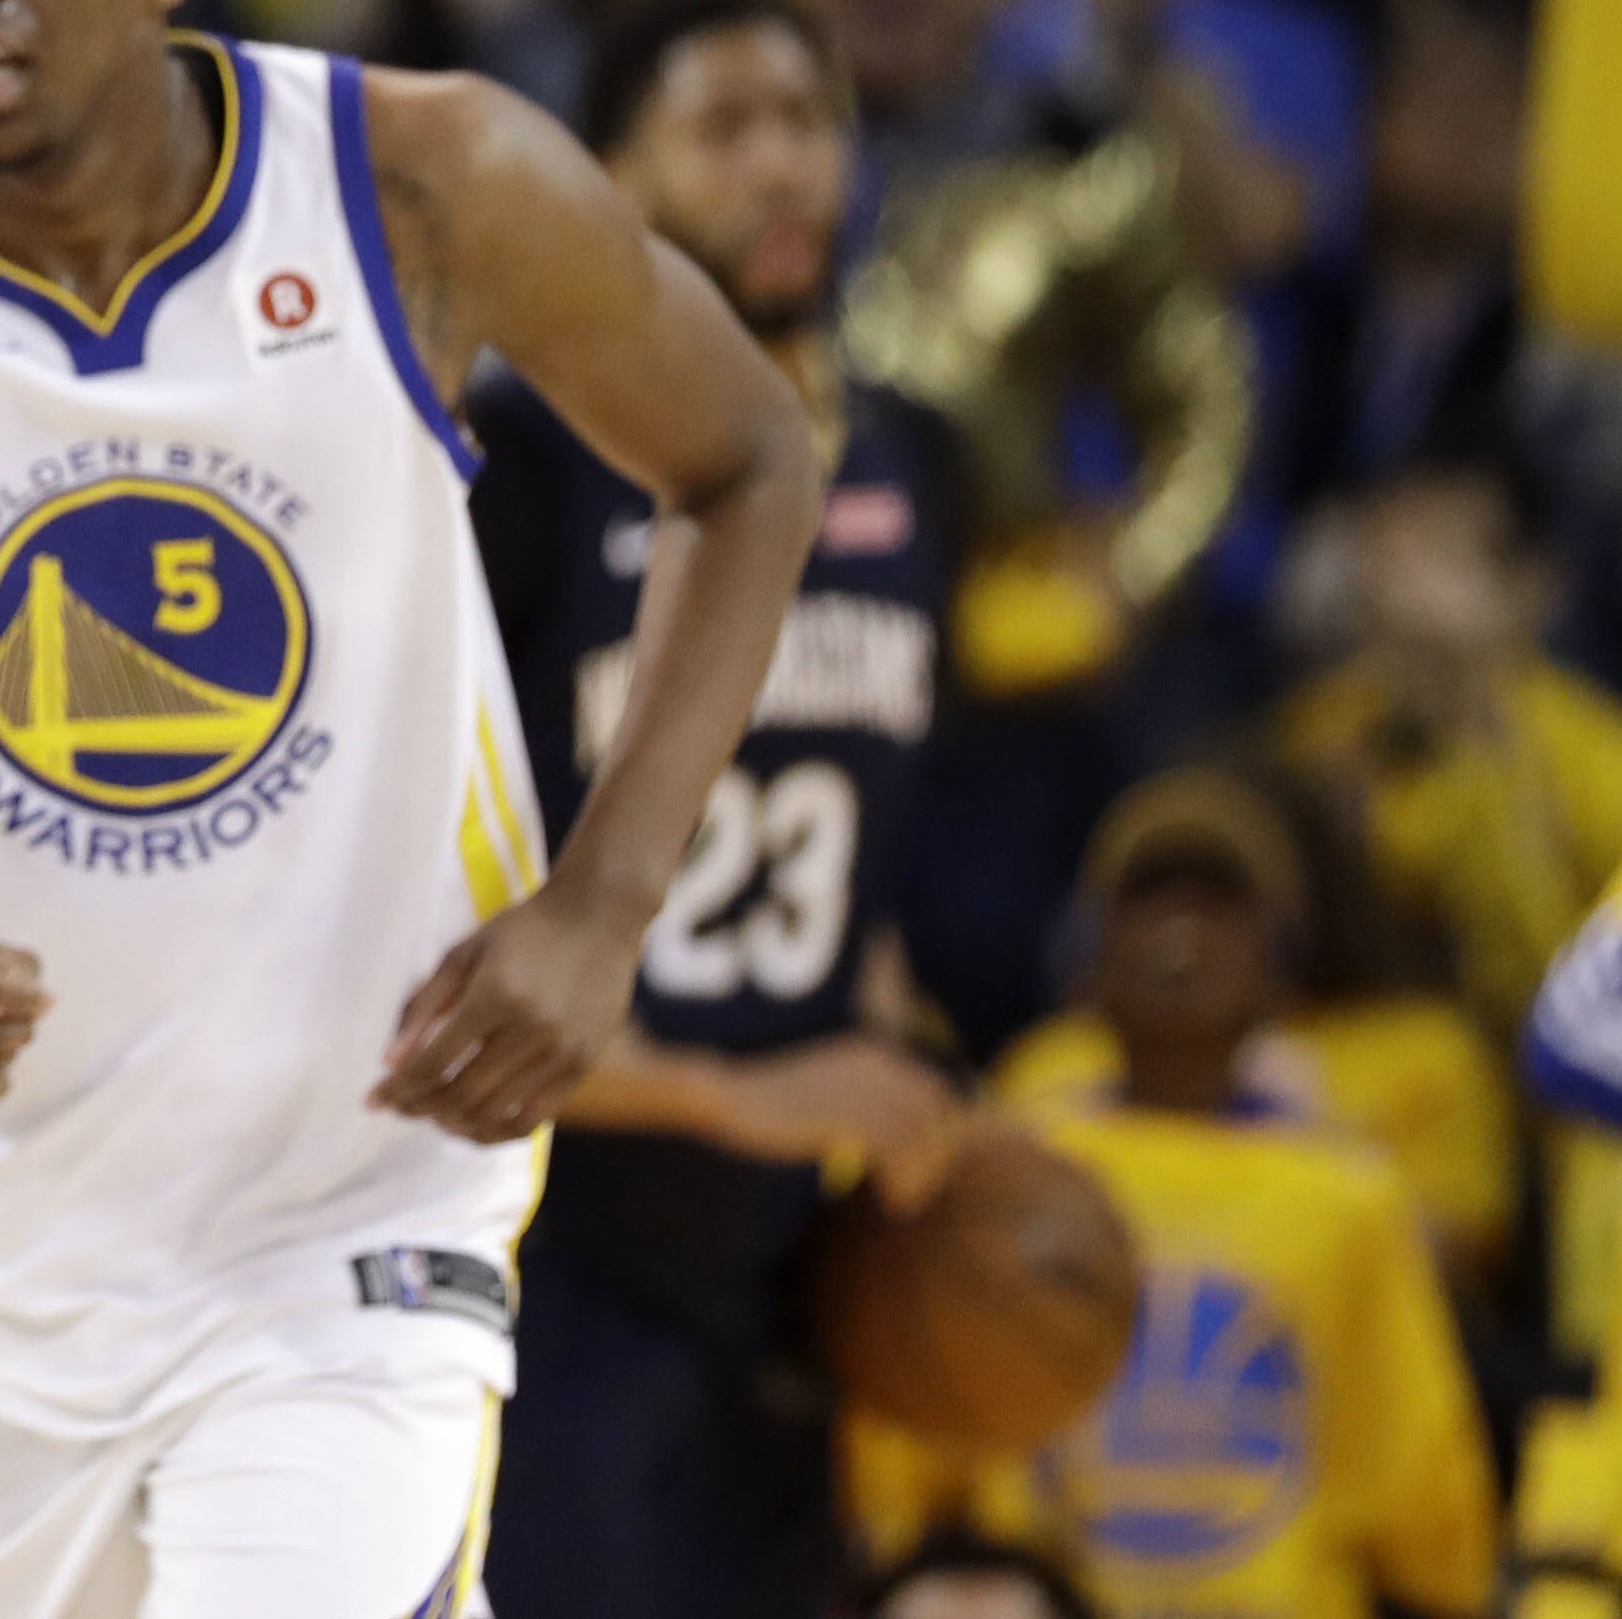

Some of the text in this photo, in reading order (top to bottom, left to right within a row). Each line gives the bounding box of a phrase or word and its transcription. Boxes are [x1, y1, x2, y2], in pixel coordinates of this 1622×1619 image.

[162, 439, 312, 532] STATE
[150, 536, 223, 635] 5
[640, 757, 860, 1003] 23
